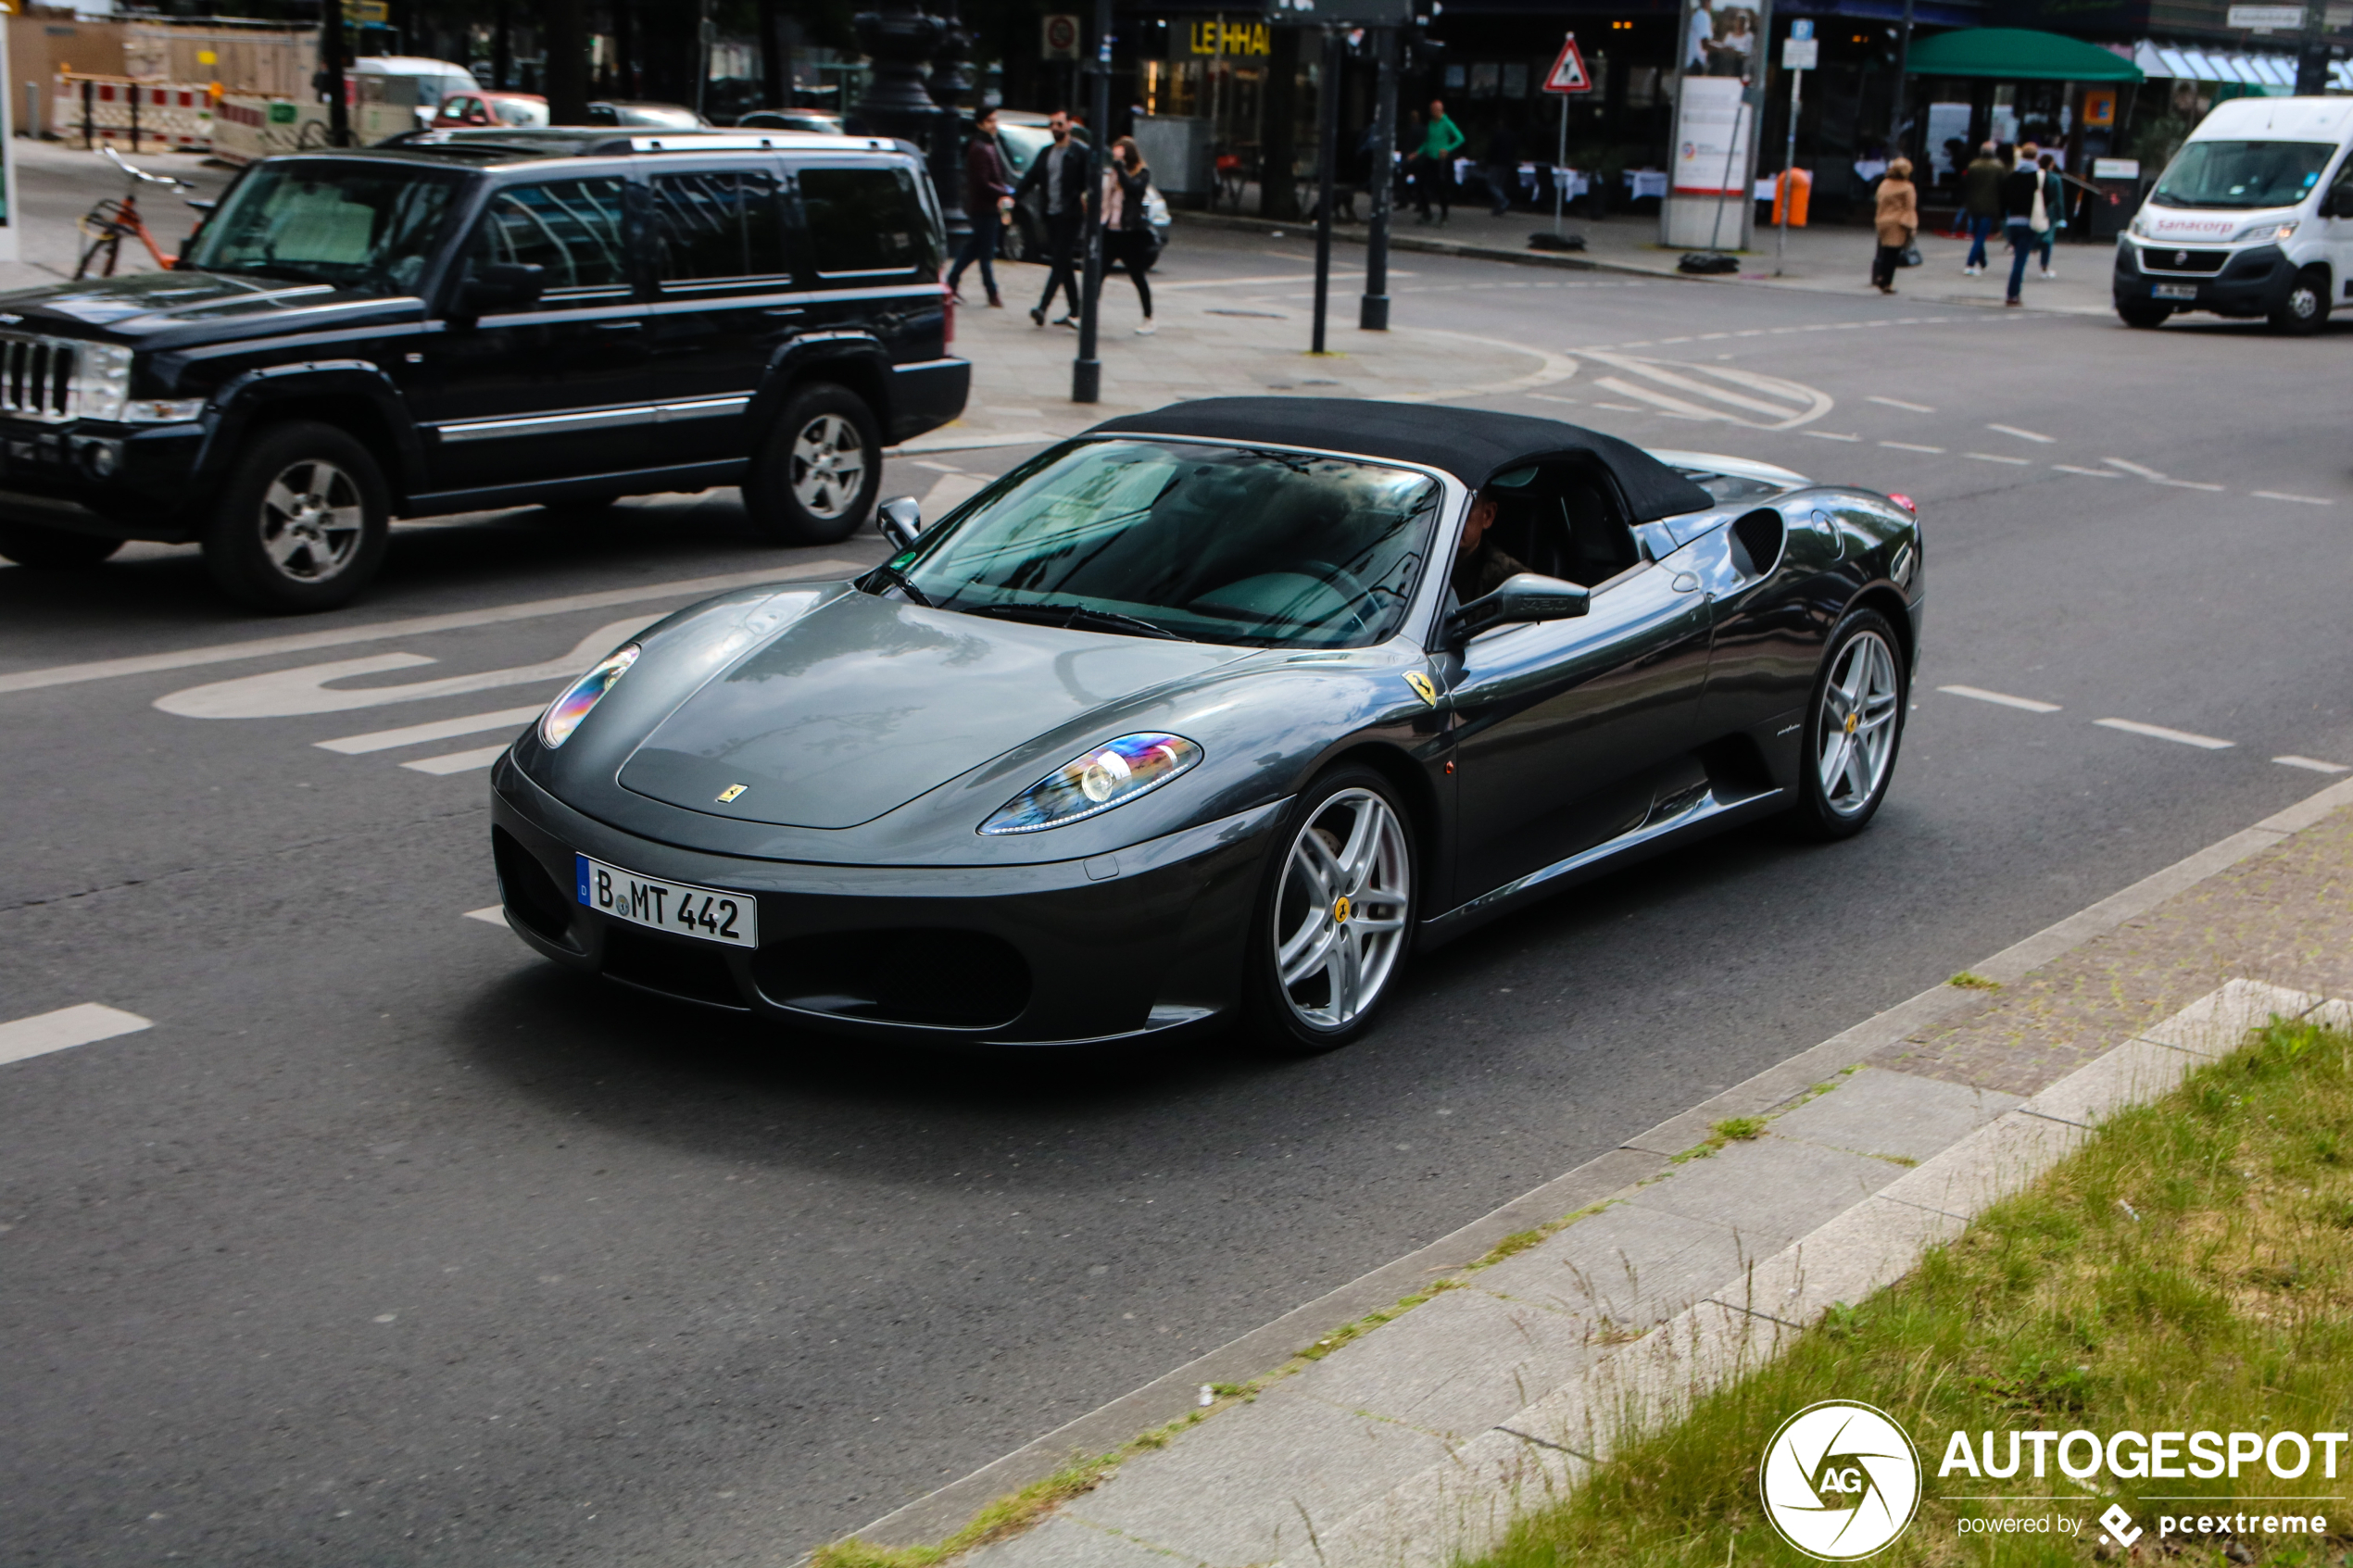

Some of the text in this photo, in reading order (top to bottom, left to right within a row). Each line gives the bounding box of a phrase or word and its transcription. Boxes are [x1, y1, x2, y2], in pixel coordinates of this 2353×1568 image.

[2156, 220, 2233, 236] Sanacorp
[598, 869, 739, 939] B MT 442
